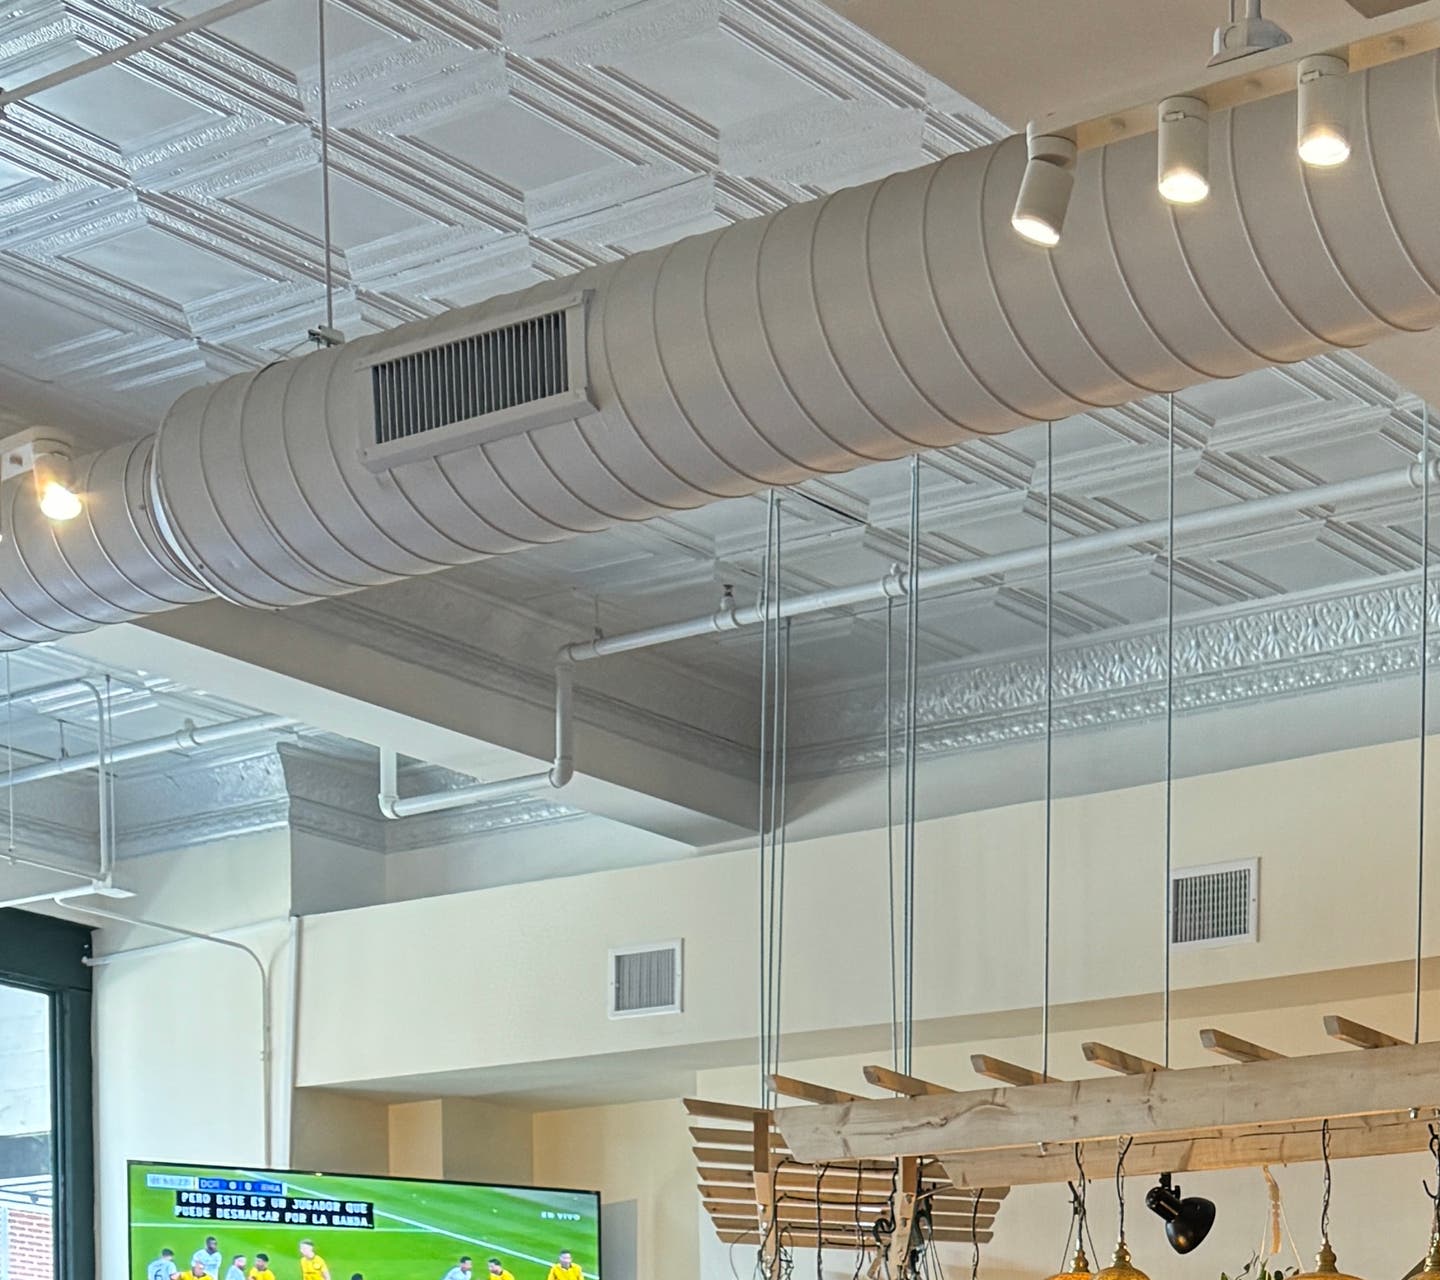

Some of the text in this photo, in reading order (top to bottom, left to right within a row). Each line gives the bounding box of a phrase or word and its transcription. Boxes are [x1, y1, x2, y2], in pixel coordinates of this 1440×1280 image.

[216, 1194, 246, 1207] ESTE
[250, 1196, 266, 1208] ES
[291, 1199, 341, 1212] JUGADOR
[345, 1202, 368, 1214] QUE
[174, 1205, 212, 1218] PUEDE
[311, 1213, 328, 1225] LA
